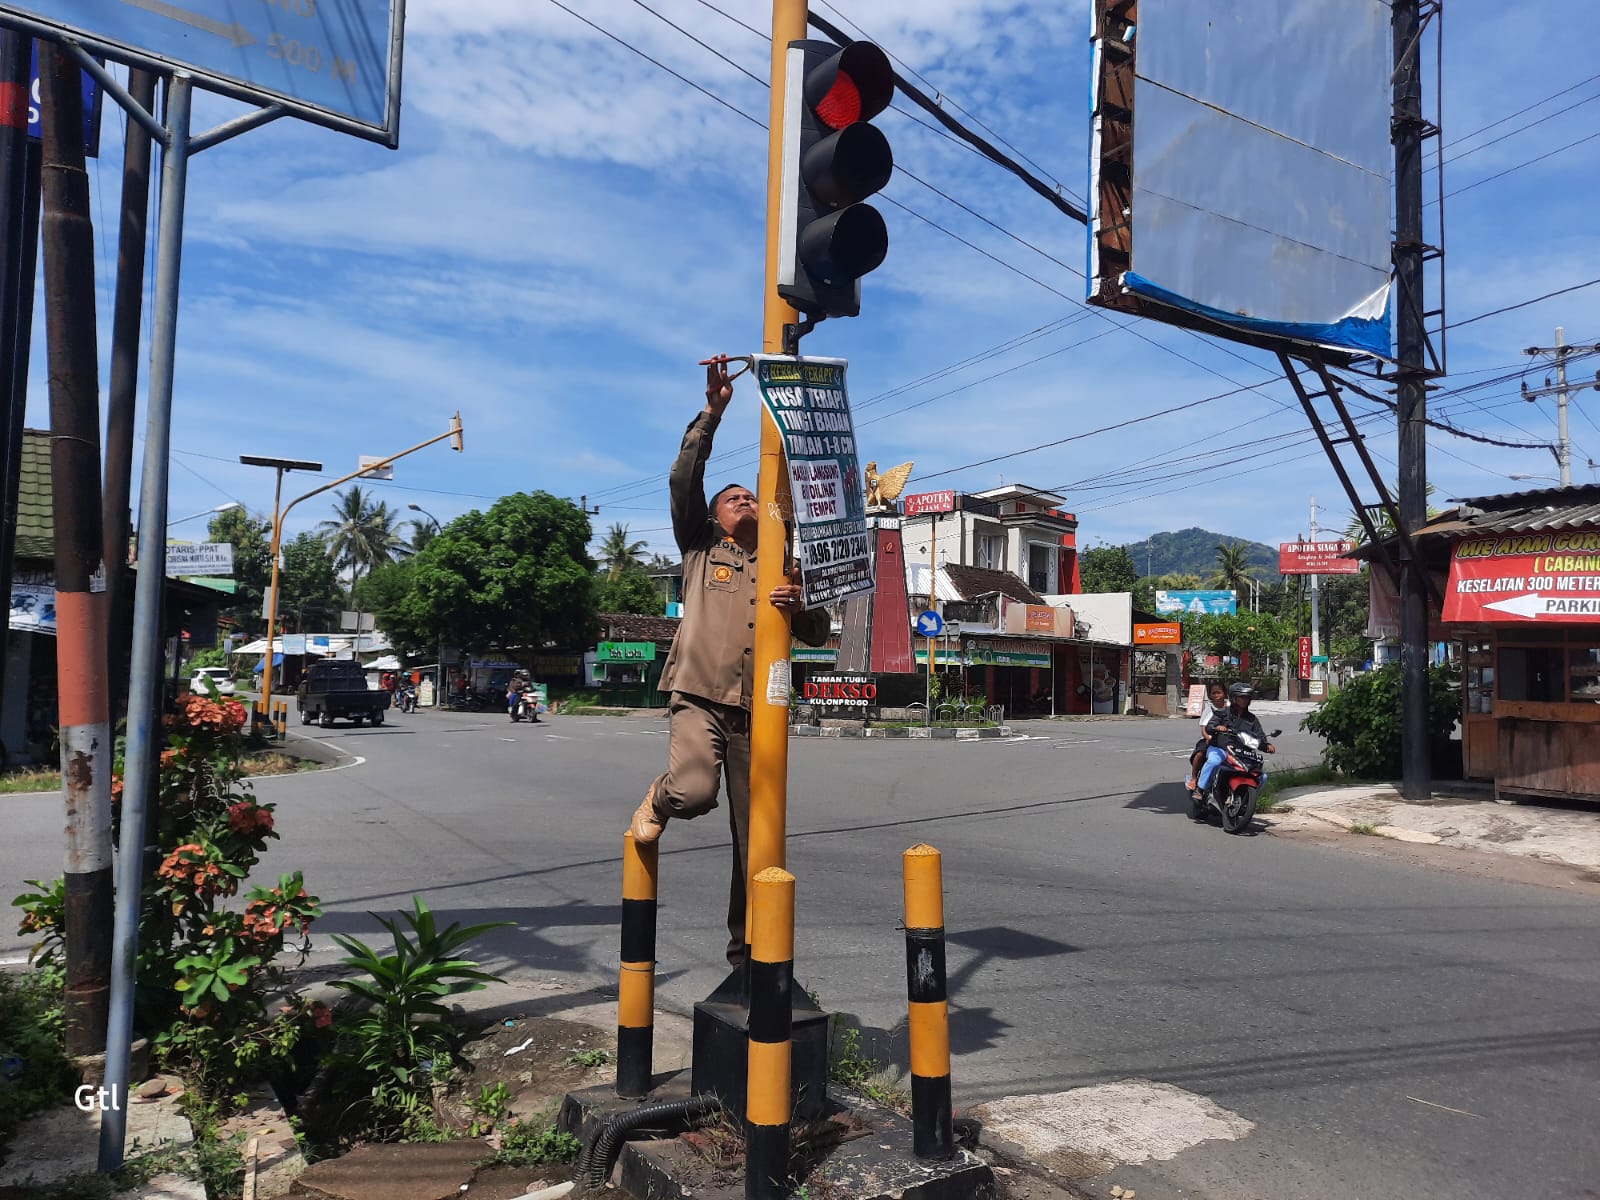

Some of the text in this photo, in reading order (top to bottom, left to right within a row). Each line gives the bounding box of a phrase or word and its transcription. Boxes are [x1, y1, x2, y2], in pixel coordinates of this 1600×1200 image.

[266, 32, 358, 86] 500 M
[766, 386, 846, 410] PUSA TERAPI
[813, 411, 851, 432] BADAN
[840, 436, 855, 455] CM
[916, 492, 951, 505] APOTEK
[199, 545, 219, 553] PPAT
[1287, 543, 1316, 553] APOTEK
[1317, 543, 1338, 552] SIAGA
[1457, 530, 1600, 558] MIE AYAM GOR
[1456, 577, 1525, 593] KESELATAN
[1526, 575, 1554, 592] 300
[1545, 599, 1600, 613] PARKI
[1301, 638, 1309, 678] APOTEK
[804, 682, 877, 699] DEKSO
[810, 698, 869, 706] KULONPROGO
